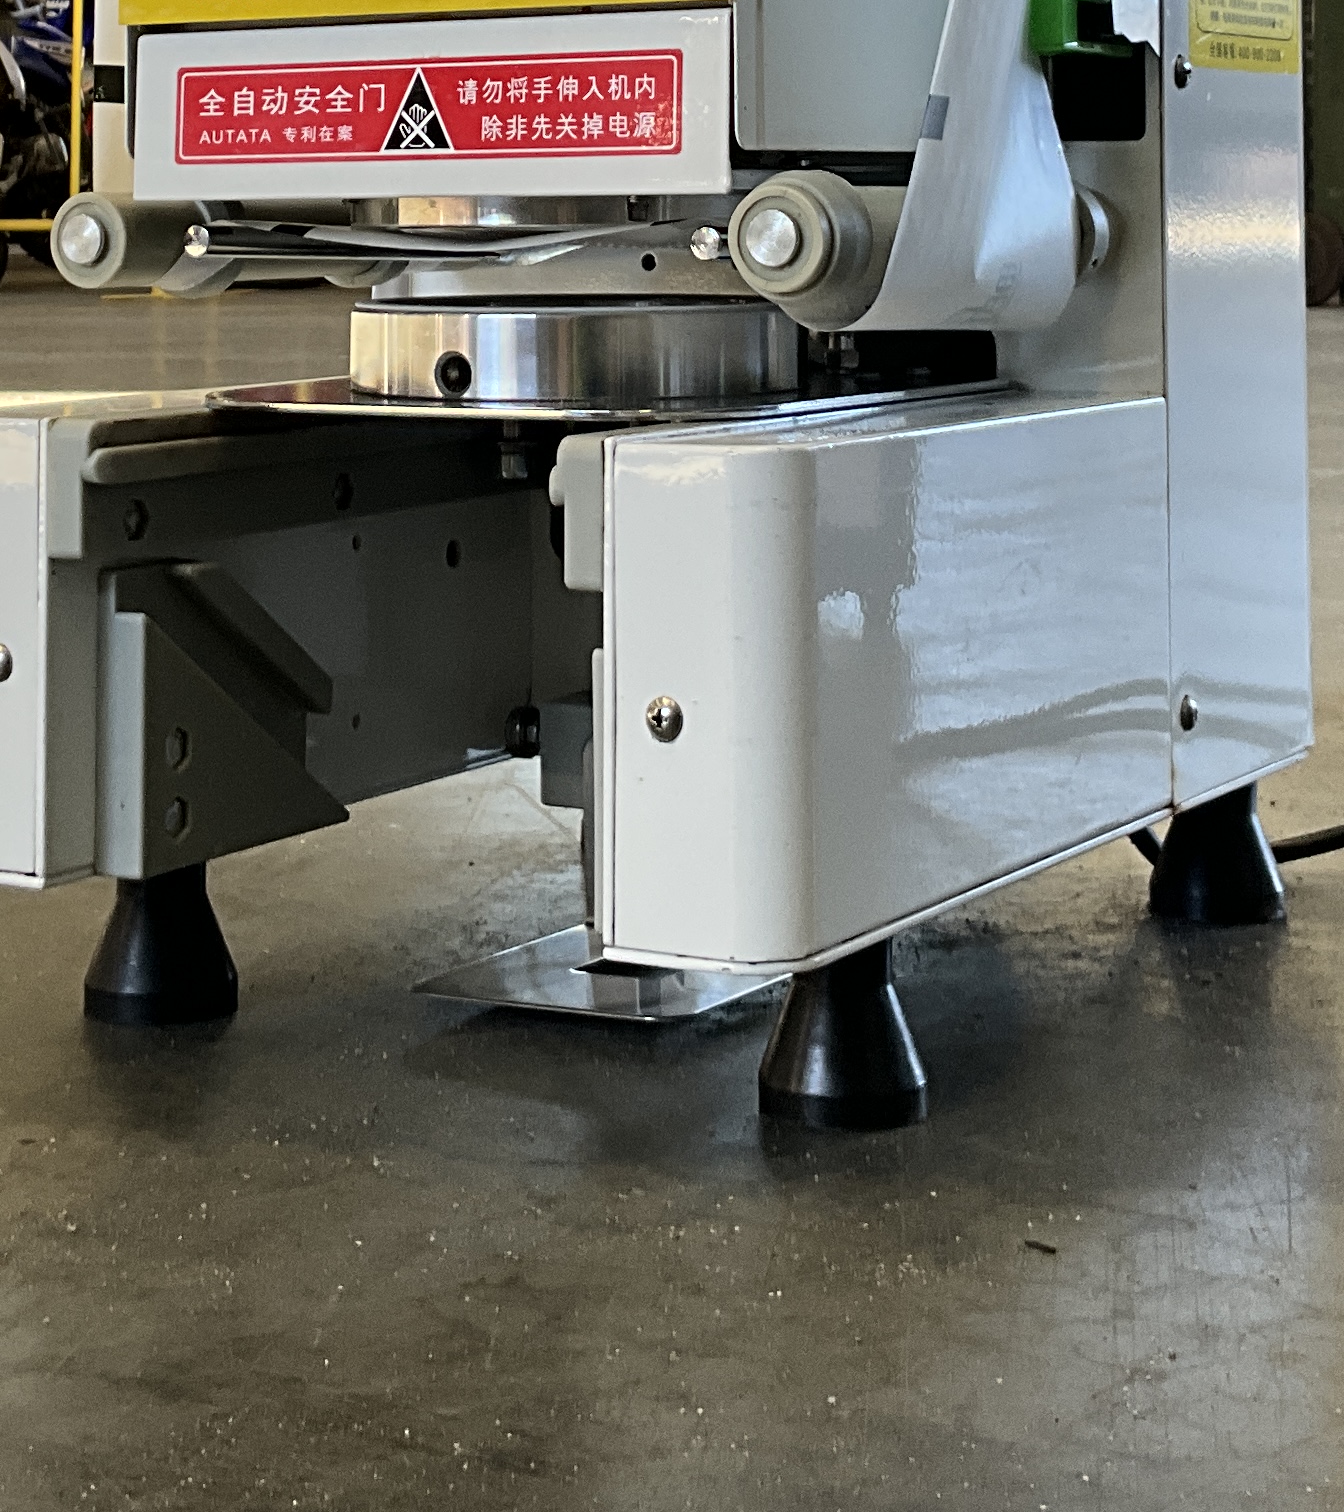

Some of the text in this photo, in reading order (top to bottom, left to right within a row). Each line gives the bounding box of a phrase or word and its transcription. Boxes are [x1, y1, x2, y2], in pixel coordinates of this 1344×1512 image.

[198, 83, 386, 117] 全自动安全门
[457, 73, 657, 106] 请勿将手伸入机内
[199, 128, 272, 144] AUTATA
[481, 111, 657, 142] 除非先关掉电源
